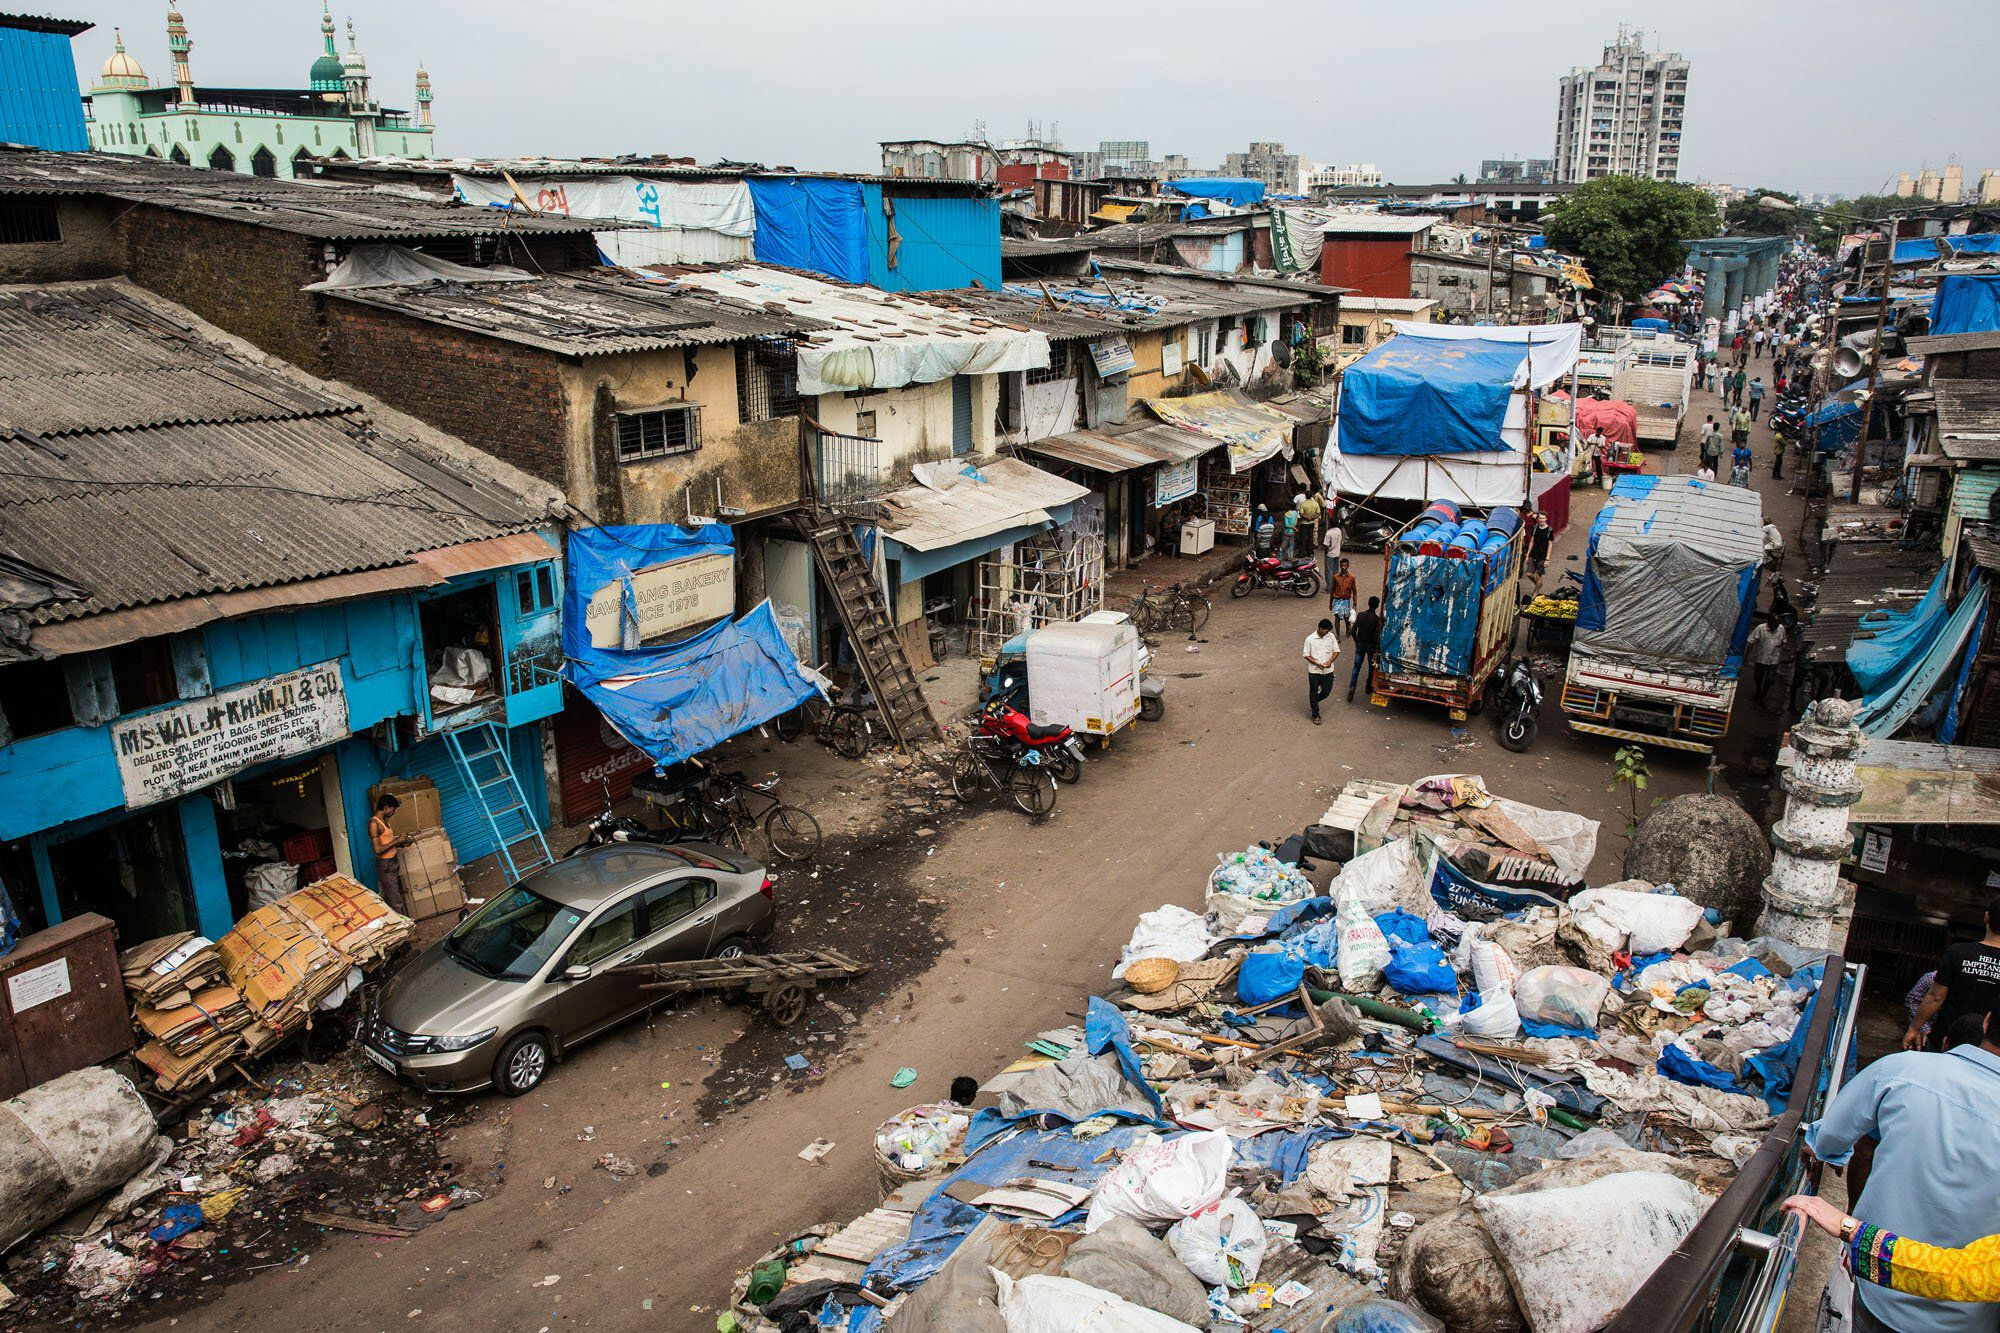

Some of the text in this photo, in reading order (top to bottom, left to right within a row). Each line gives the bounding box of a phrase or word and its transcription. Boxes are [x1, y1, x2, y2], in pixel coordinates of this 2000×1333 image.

[586, 568, 730, 619] NAVAANG BAKERY
[226, 684, 295, 725] KHIMJI
[298, 679, 314, 702] &
[133, 747, 175, 767] DEALERS
[193, 731, 225, 750] EMPTY
[143, 774, 165, 788] PLOT
[244, 737, 277, 755] RAILWAY
[151, 760, 172, 774] AND
[175, 748, 208, 766] CARPET
[213, 732, 257, 753] FLOORING
[260, 722, 290, 739] SHEETS
[1448, 893, 1496, 910] SUNDAY
[1473, 891, 1498, 903] OCT
[1979, 954, 1998, 966] HELL
